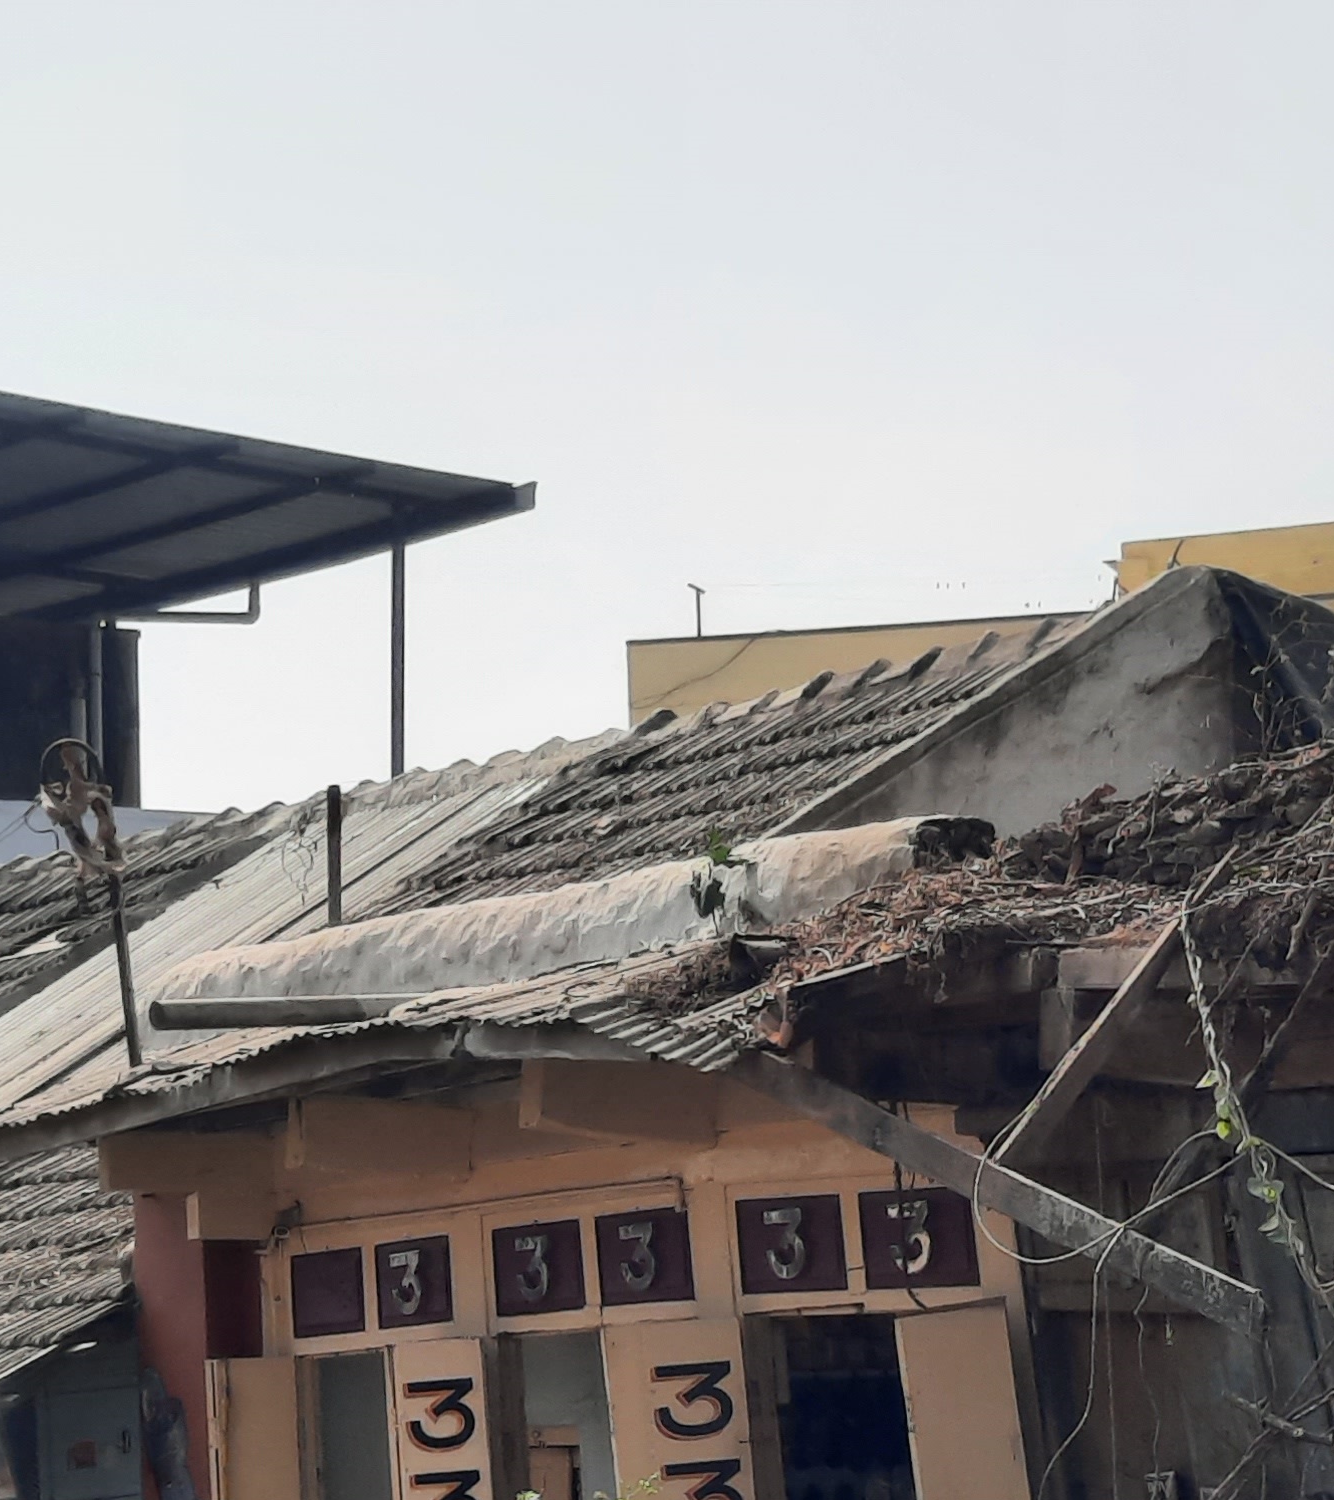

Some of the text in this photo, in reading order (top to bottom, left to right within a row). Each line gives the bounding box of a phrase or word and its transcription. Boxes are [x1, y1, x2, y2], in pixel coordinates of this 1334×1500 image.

[514, 1234, 549, 1302] 3
[618, 1221, 656, 1291] 3
[763, 1206, 805, 1280] 3
[885, 1199, 931, 1275] 3
[388, 1249, 422, 1316] 3
